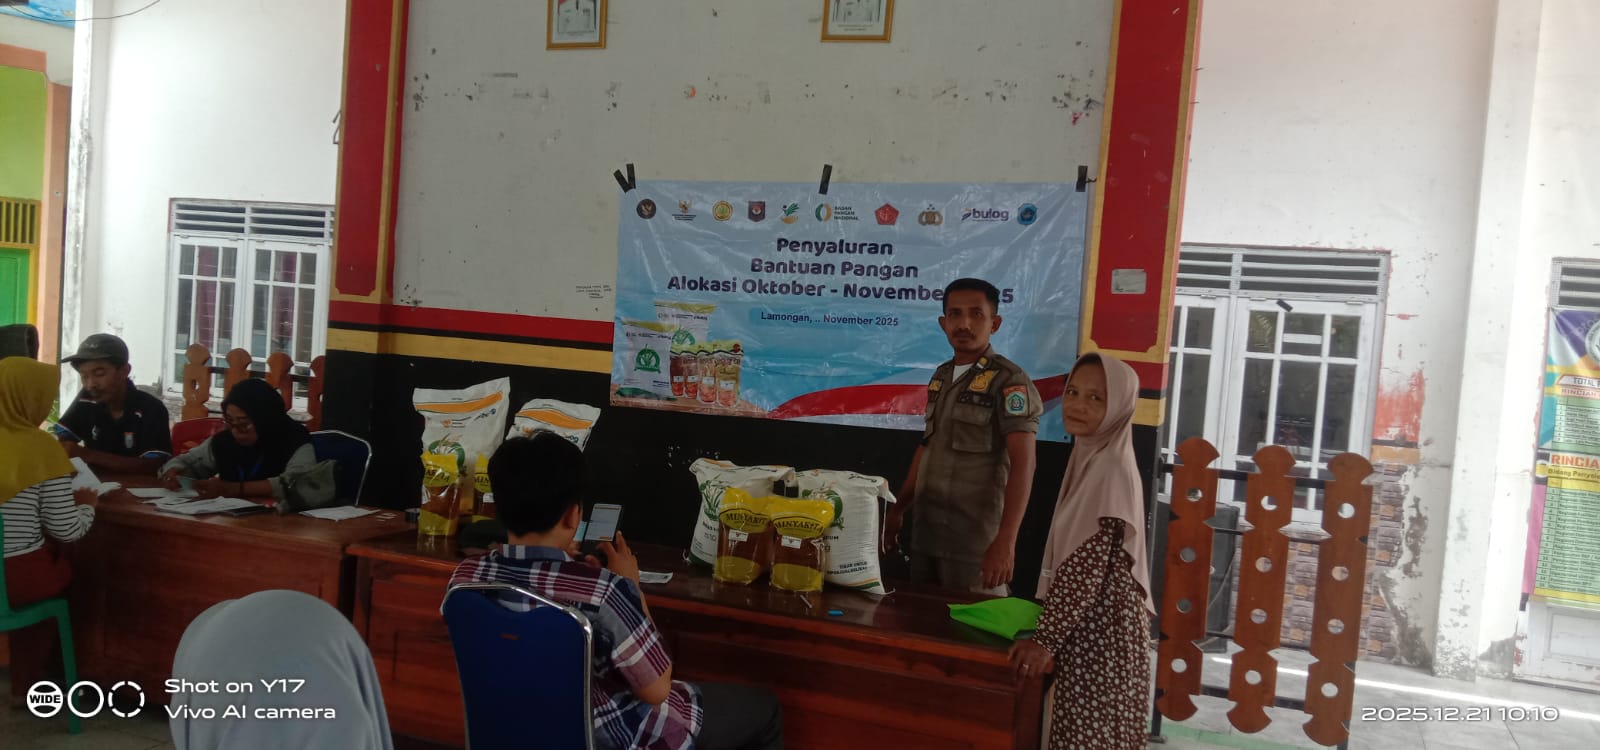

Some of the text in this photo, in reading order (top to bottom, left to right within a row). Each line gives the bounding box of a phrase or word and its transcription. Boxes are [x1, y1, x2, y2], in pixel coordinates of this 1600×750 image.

[973, 208, 1009, 221] bulog
[776, 238, 893, 256] Penyaluran
[750, 258, 919, 280] Bantuan Pangan
[667, 276, 737, 293] Alokasi
[742, 278, 826, 297] Oktober
[844, 283, 944, 302] Novembe
[761, 311, 813, 324] Lamongan,
[823, 314, 873, 325] November
[875, 316, 899, 326] 2025
[1573, 377, 1594, 386] TOTAL
